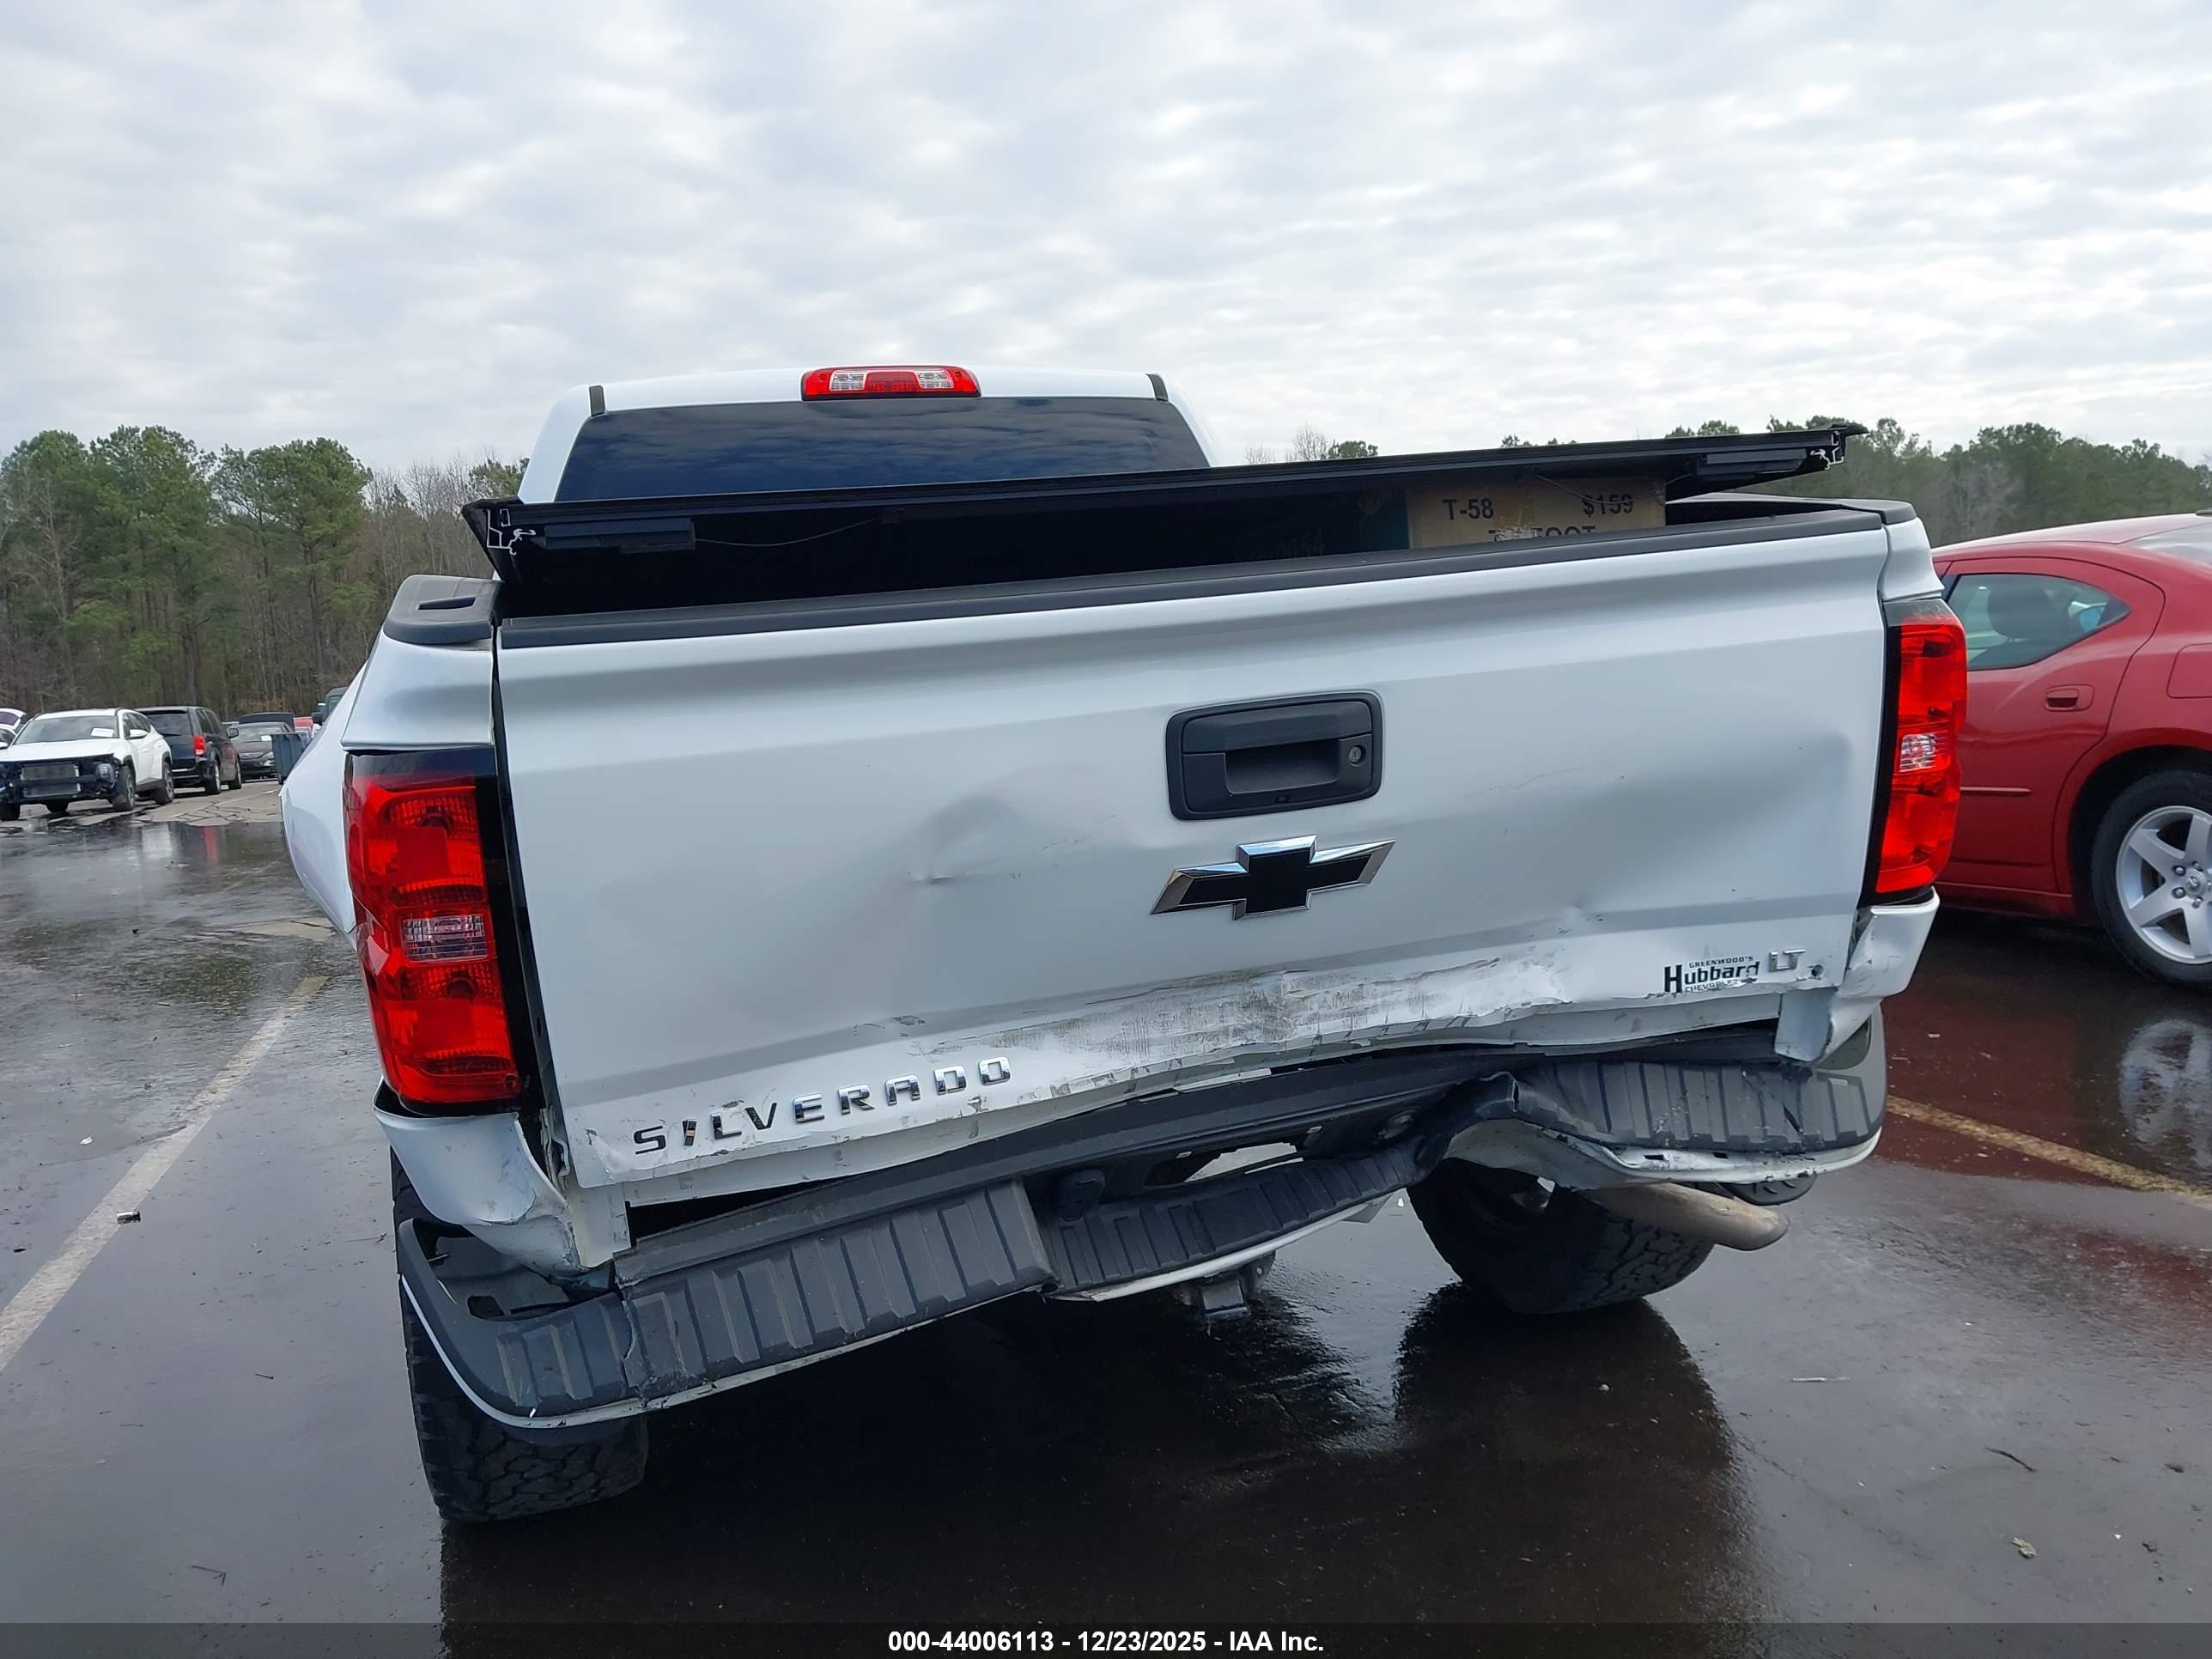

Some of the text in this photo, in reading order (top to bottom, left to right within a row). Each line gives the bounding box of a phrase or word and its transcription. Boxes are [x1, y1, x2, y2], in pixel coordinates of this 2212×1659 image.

[1443, 494, 1634, 520] T-58 $159
[1769, 949, 1806, 972] LT
[1664, 961, 1760, 994] Hubbard
[633, 1056, 1012, 1155] SILVERADO
